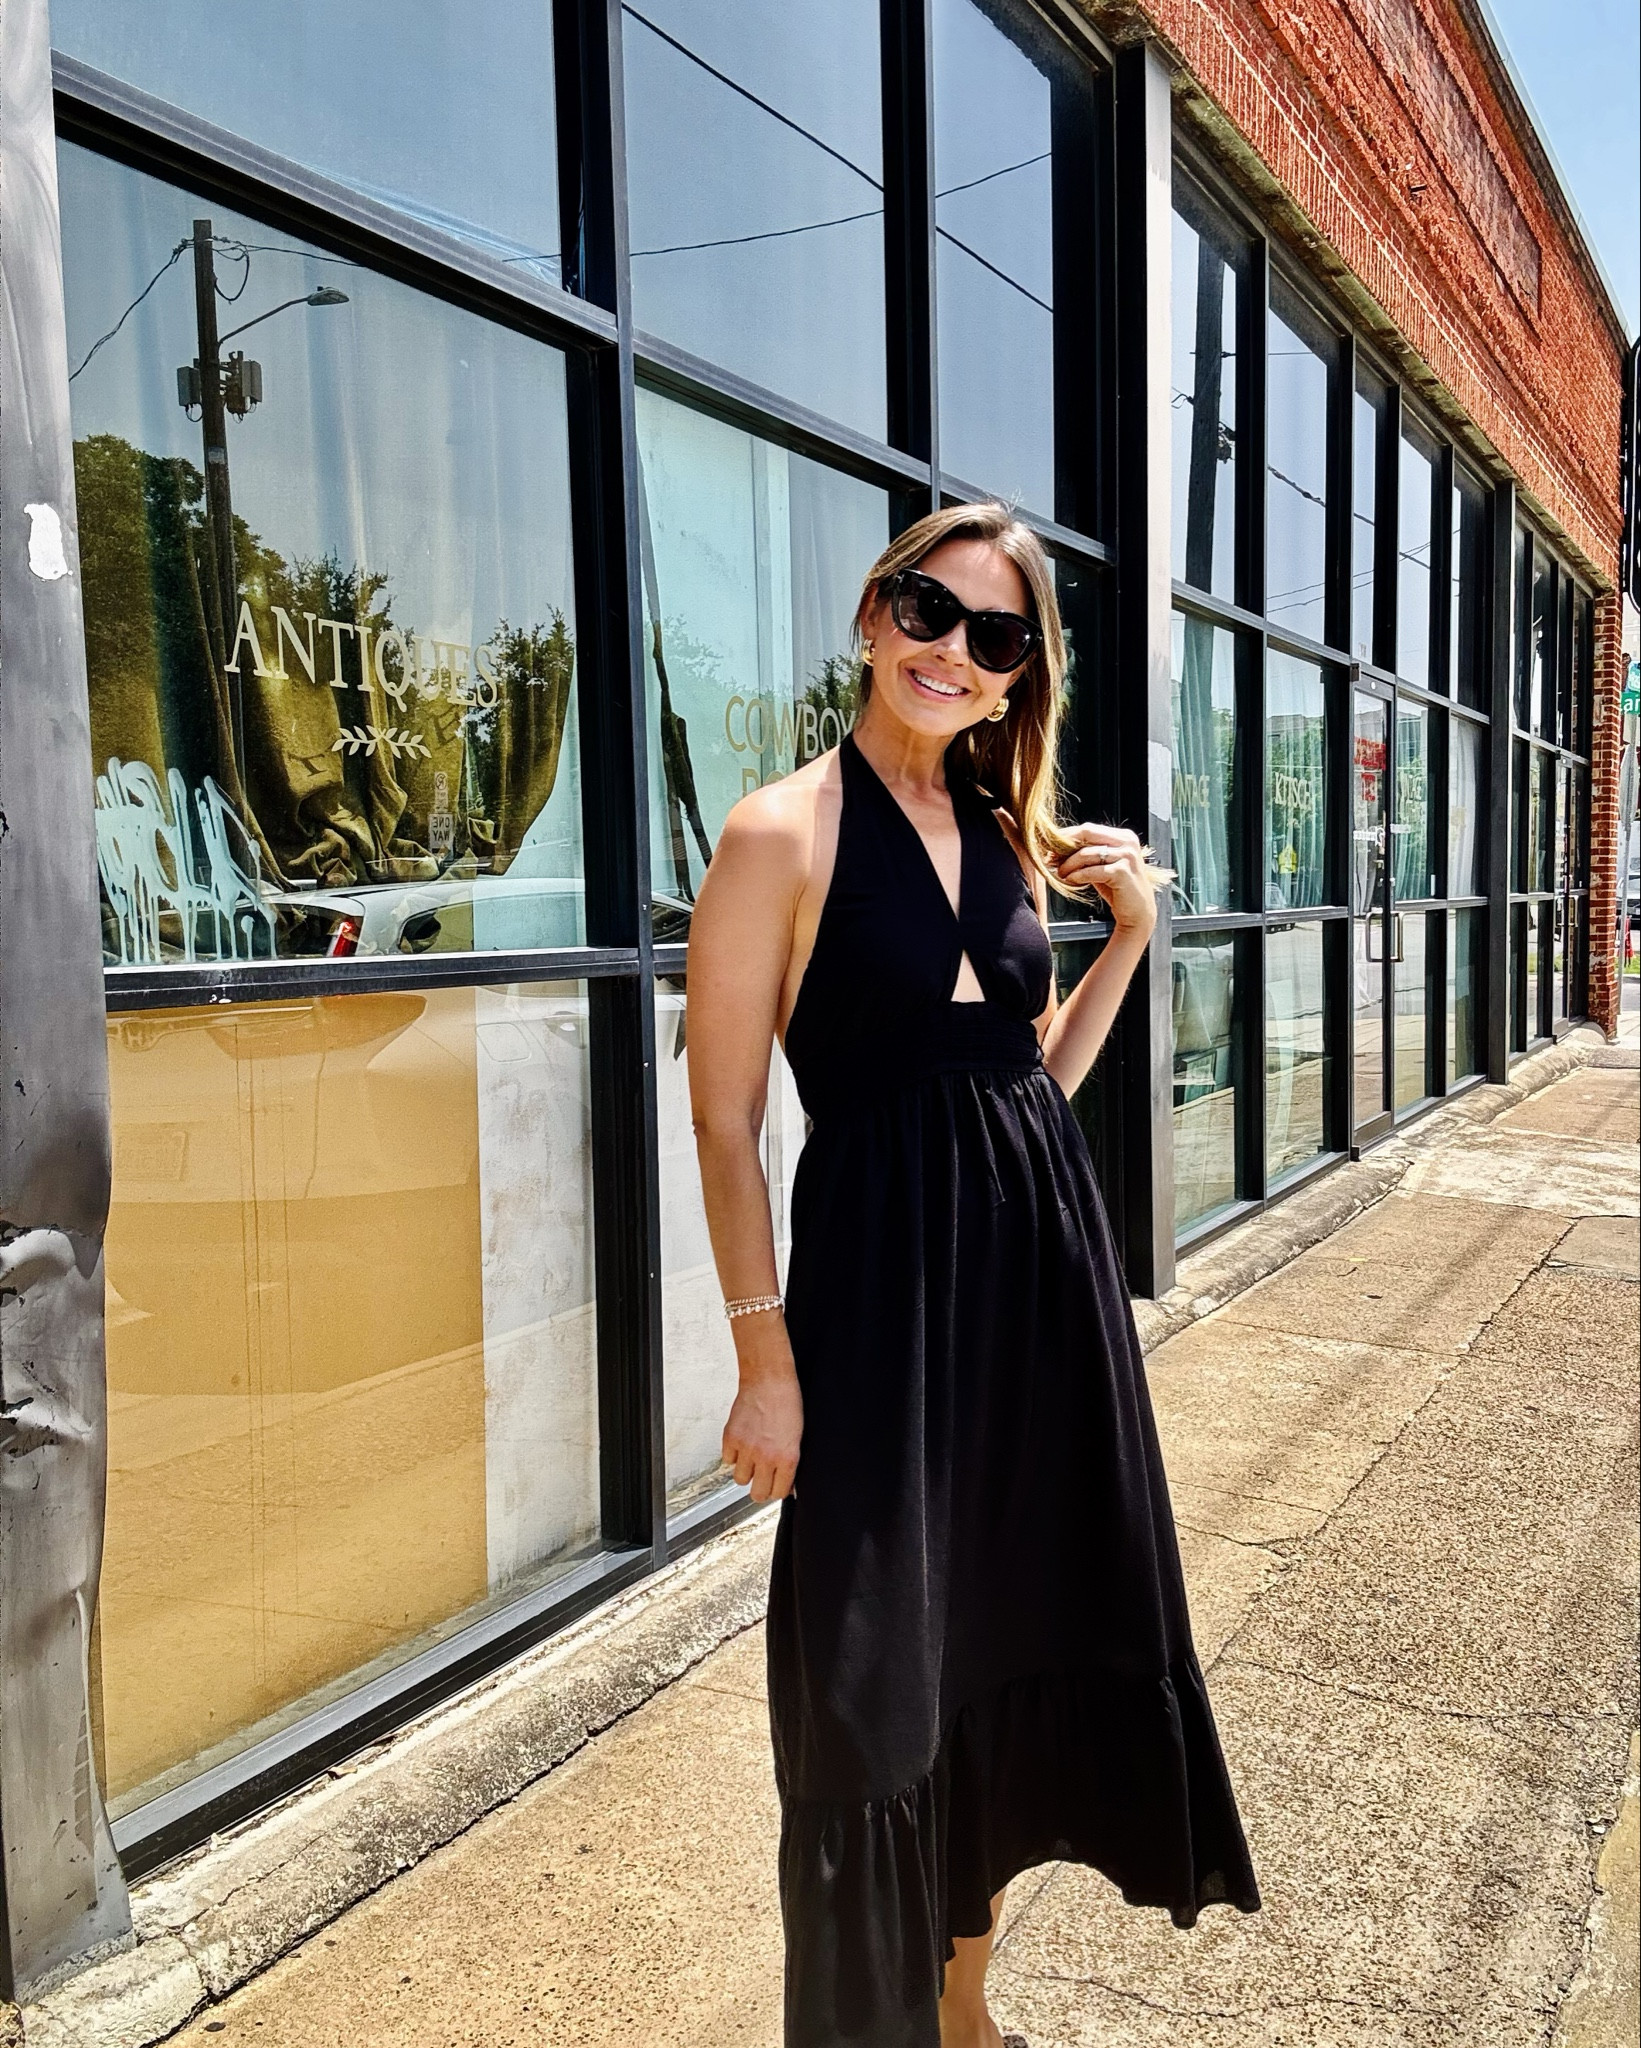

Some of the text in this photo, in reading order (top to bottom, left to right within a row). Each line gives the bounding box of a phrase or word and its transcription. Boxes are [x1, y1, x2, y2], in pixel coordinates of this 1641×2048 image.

[223, 600, 498, 712] ANTIQUES
[725, 695, 857, 760] COWBOY
[1273, 771, 1313, 812] KITSCH
